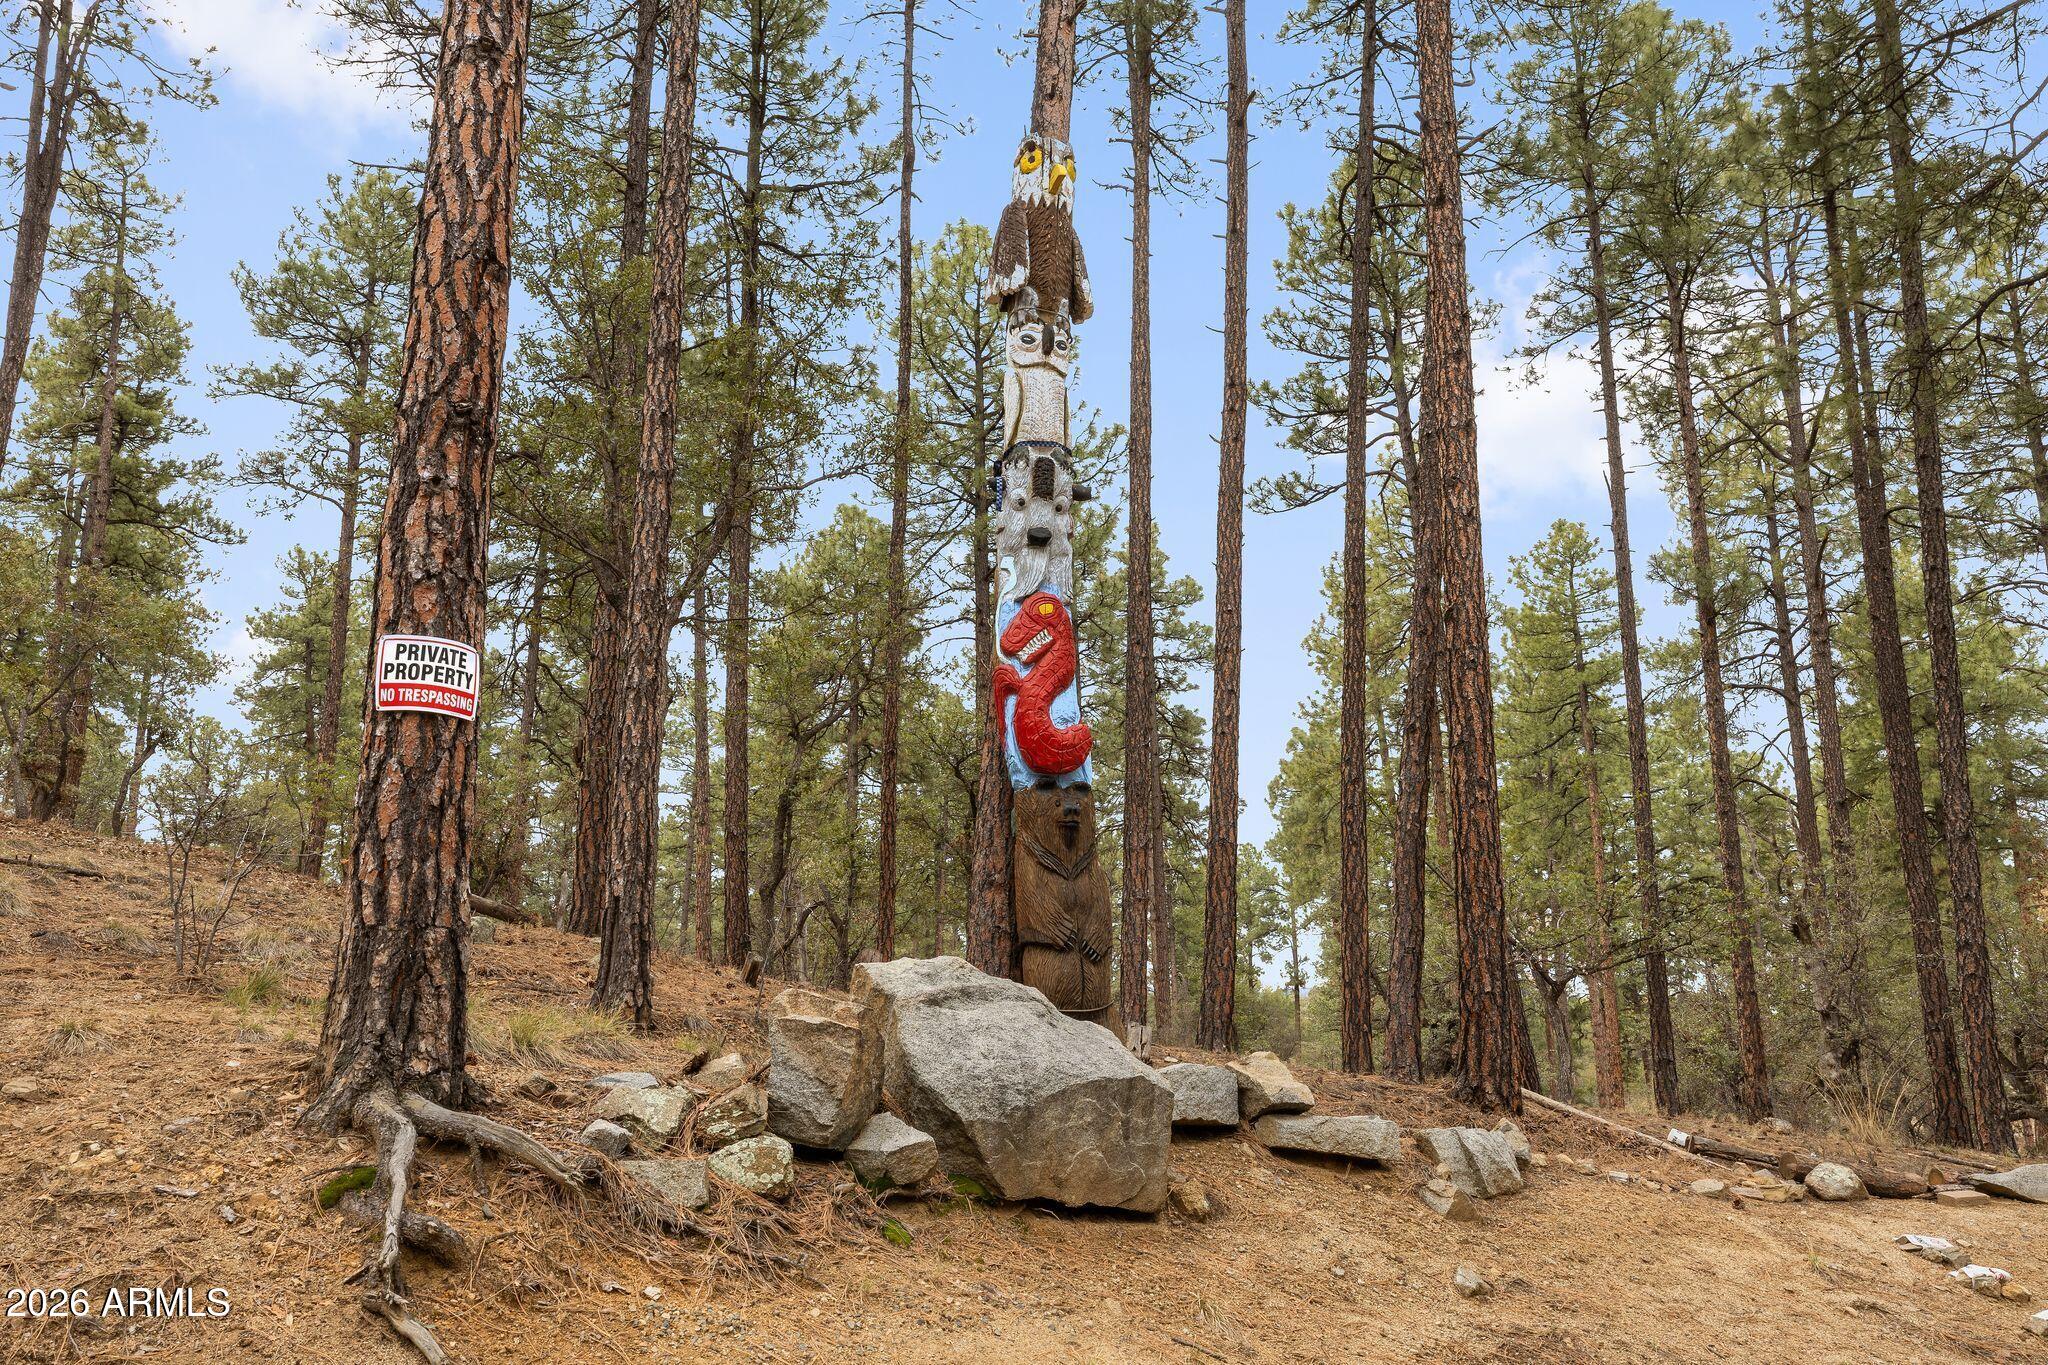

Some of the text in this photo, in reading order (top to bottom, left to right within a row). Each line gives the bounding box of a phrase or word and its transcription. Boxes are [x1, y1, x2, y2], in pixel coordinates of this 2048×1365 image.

[395, 644, 467, 669] PRIVATE
[384, 663, 473, 689] PROPERTY
[381, 688, 472, 711] NO TRESPASSING
